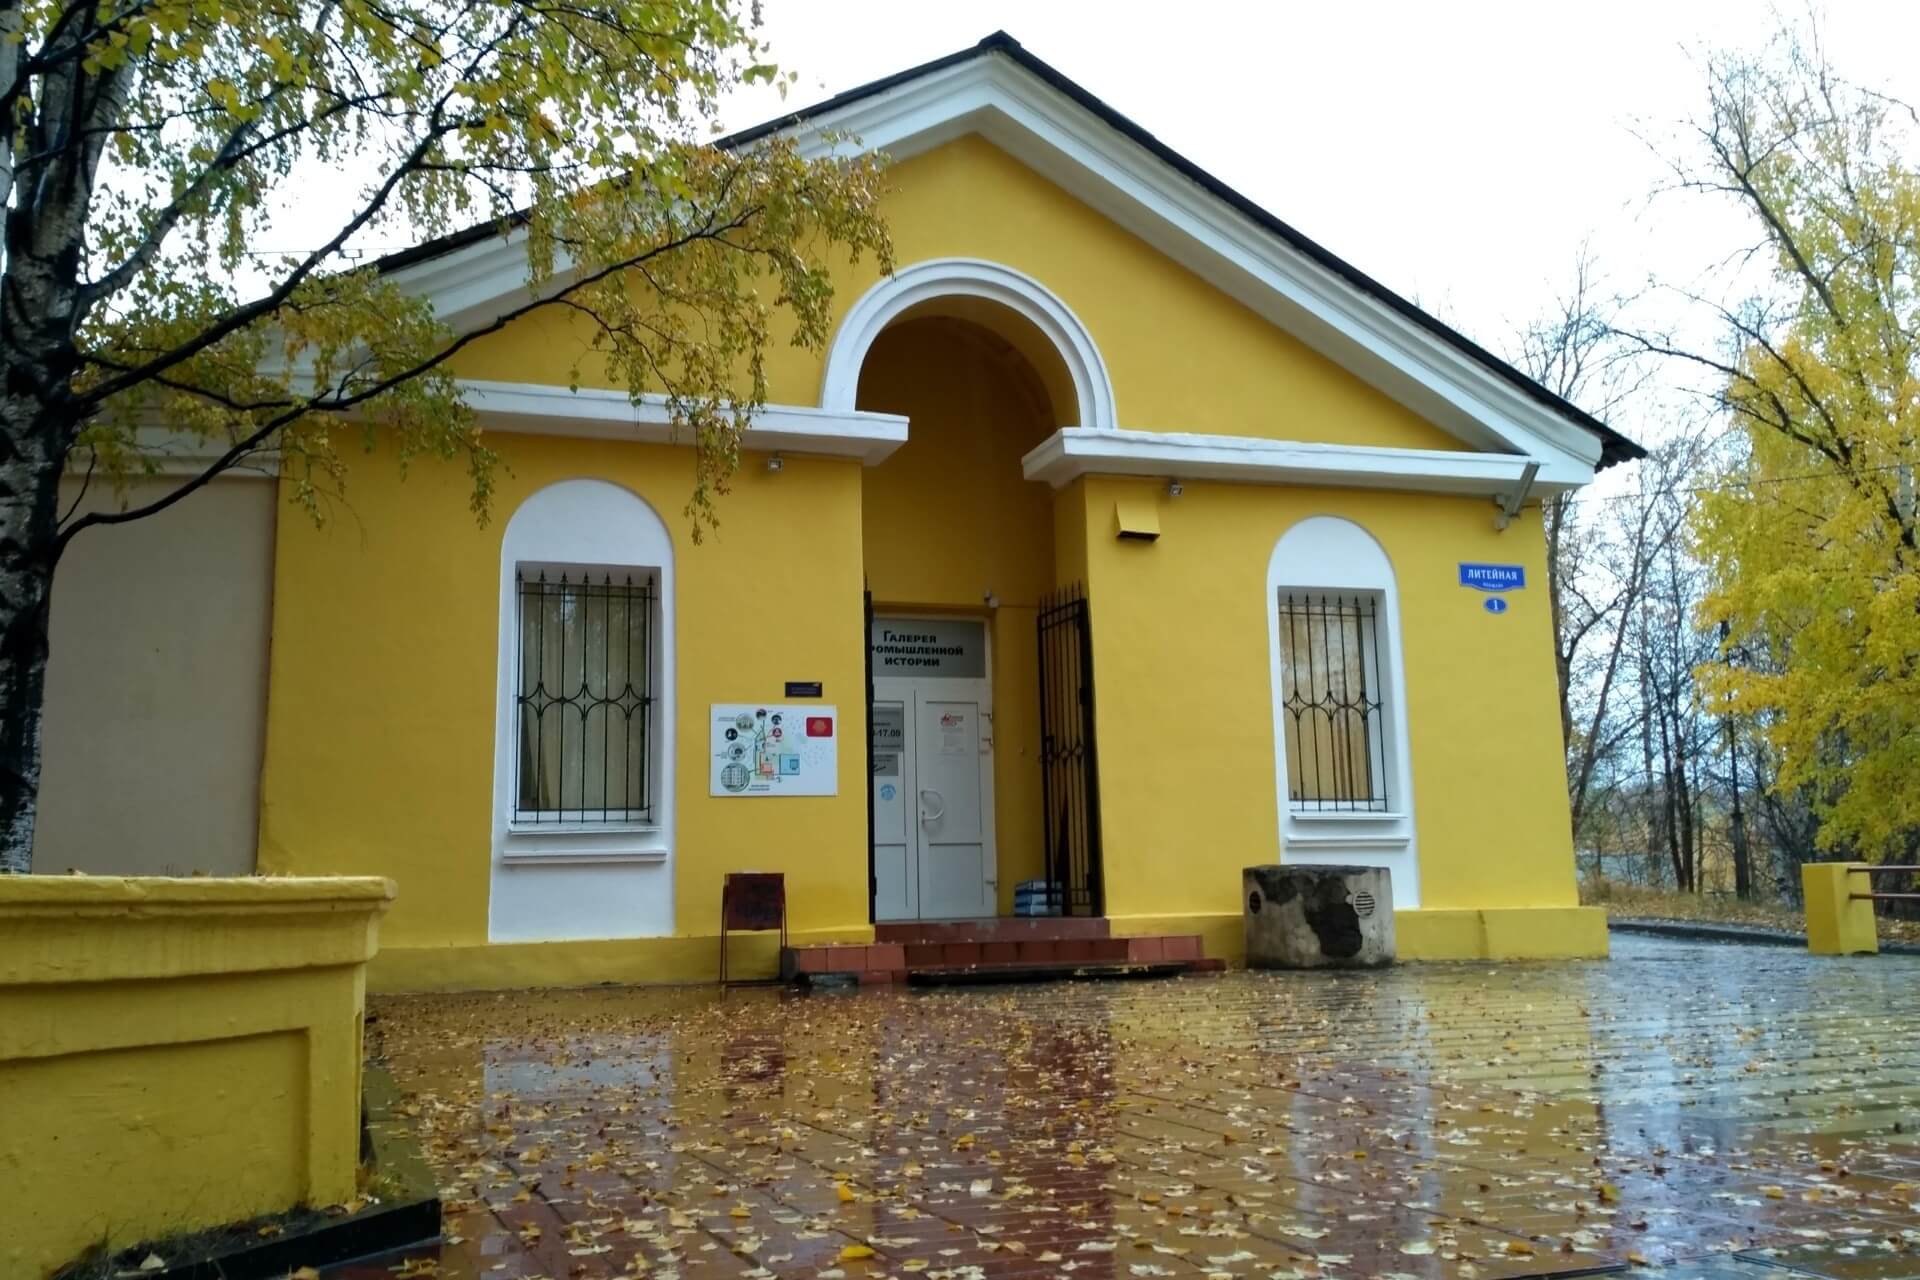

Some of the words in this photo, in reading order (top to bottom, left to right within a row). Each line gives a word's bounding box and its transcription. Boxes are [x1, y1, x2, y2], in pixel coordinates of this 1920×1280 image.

[1467, 568, 1518, 581] ЛИТЕЙНАЯ
[1493, 599, 1499, 611] 1
[884, 657, 940, 667] ИСТОРИИ
